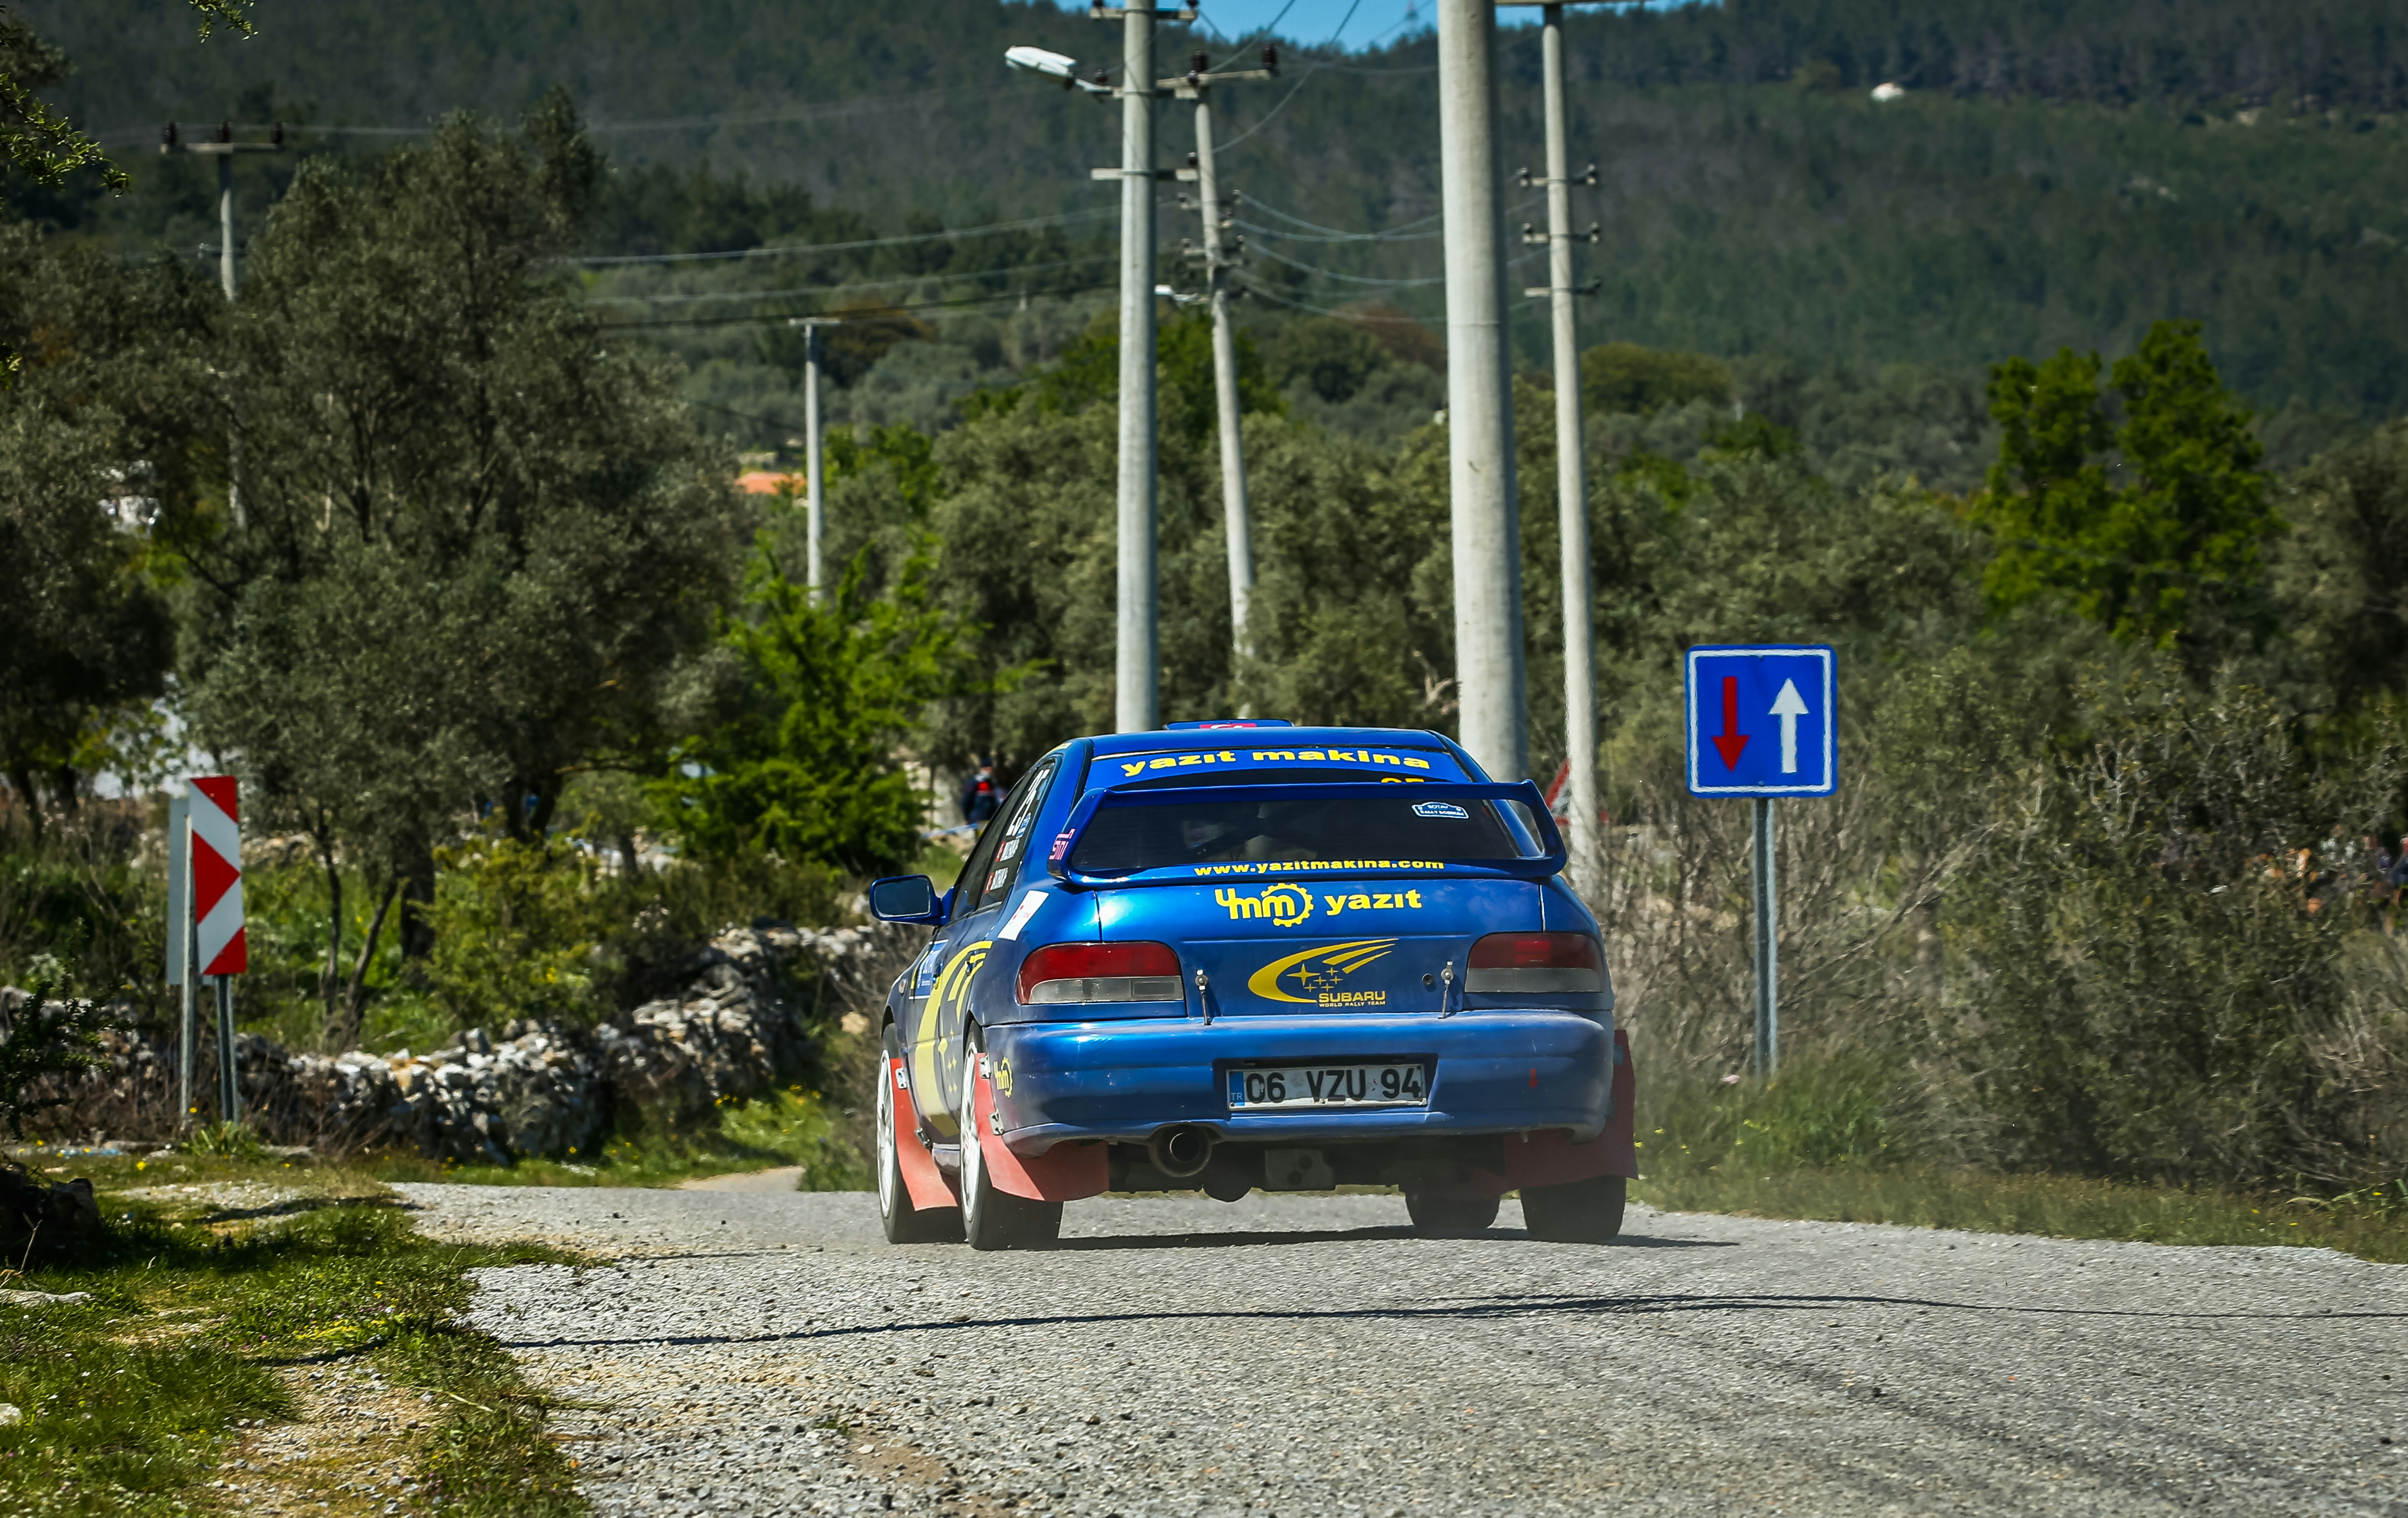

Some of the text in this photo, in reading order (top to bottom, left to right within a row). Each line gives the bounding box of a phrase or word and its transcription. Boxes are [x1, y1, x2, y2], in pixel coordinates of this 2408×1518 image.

[1252, 749, 1430, 769] makina
[1194, 858, 1444, 876] www.yazitmakina.com
[1319, 990, 1385, 1003] SUBARU
[1306, 1068, 1366, 1102] VZU
[1381, 1067, 1421, 1099] 94
[1231, 1092, 1243, 1101] TR
